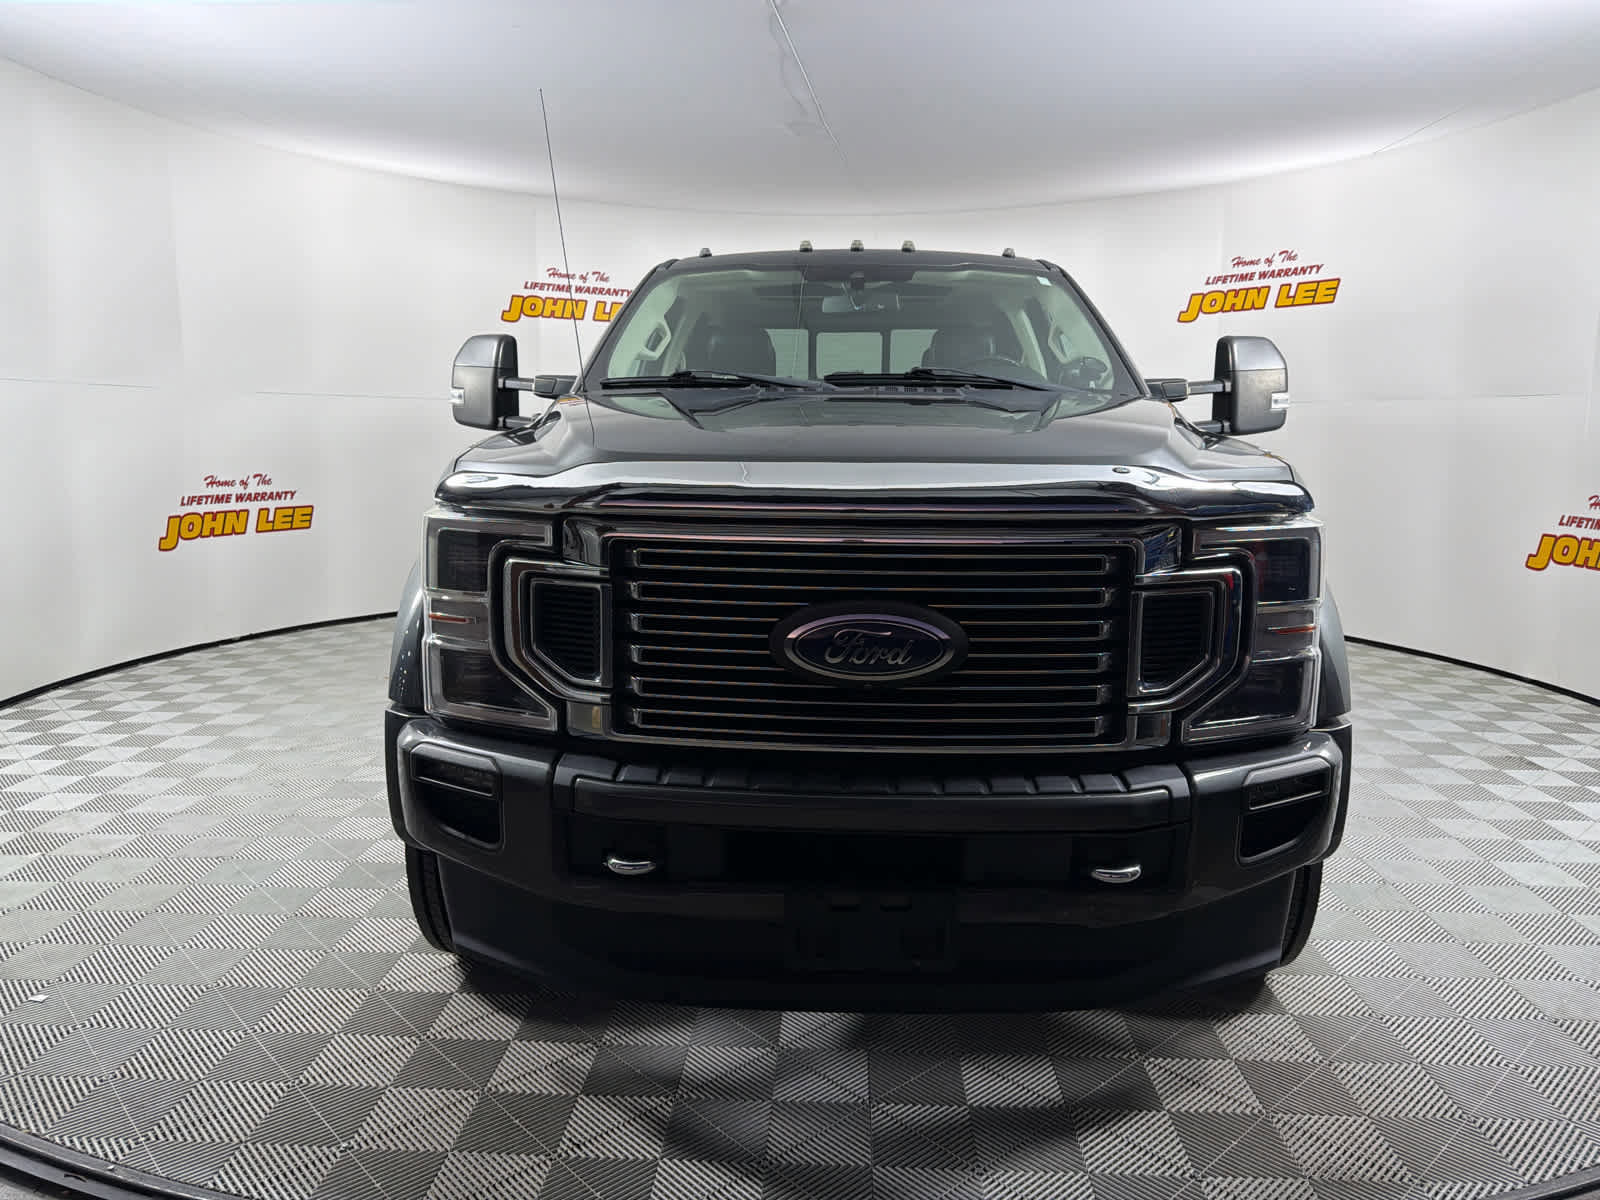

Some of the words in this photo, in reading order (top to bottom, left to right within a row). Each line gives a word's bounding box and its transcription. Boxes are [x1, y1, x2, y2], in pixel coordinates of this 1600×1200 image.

[1231, 256, 1261, 268] Home
[1264, 253, 1275, 266] of
[1279, 250, 1298, 263] The
[546, 267, 577, 280] Home
[579, 272, 588, 283] of
[591, 271, 609, 282] The
[1205, 272, 1256, 285] LIFETIME
[1258, 264, 1324, 281] WARRANTY
[524, 281, 572, 293] LIFETIME
[574, 285, 632, 297] WARRANTY
[501, 295, 587, 322] JOHN
[1177, 285, 1271, 323] JOHN
[1274, 278, 1341, 308] LEE
[203, 475, 236, 488] Home
[239, 476, 250, 489] of
[253, 473, 272, 486] The
[180, 494, 232, 507] LIFETIME
[235, 490, 296, 503] WARRANTY
[158, 509, 249, 551] JOHN
[255, 505, 314, 533] LEE
[1525, 533, 1600, 571] JOH
[824, 628, 914, 665] Ford
